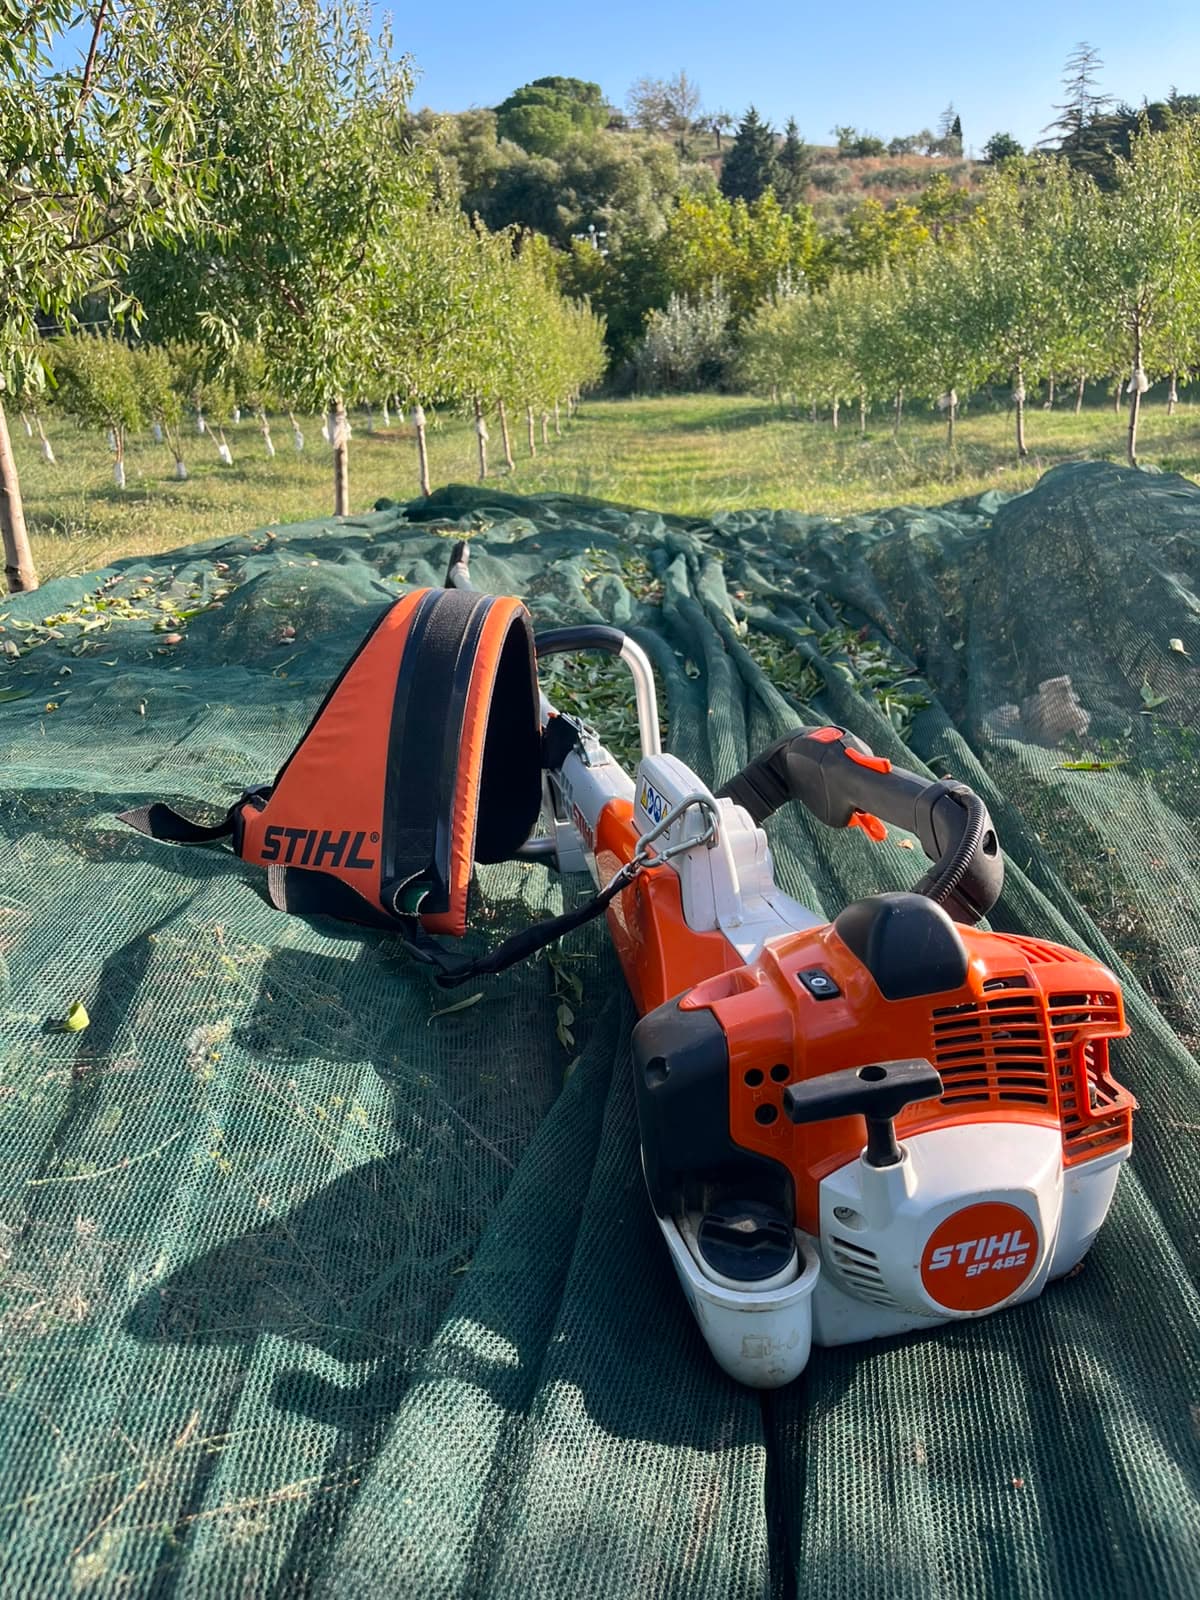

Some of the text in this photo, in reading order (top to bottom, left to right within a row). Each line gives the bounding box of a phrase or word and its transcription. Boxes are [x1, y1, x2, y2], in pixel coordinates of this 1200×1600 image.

[928, 1230, 1031, 1270] STIHL
[965, 1253, 1028, 1278] SP 482
